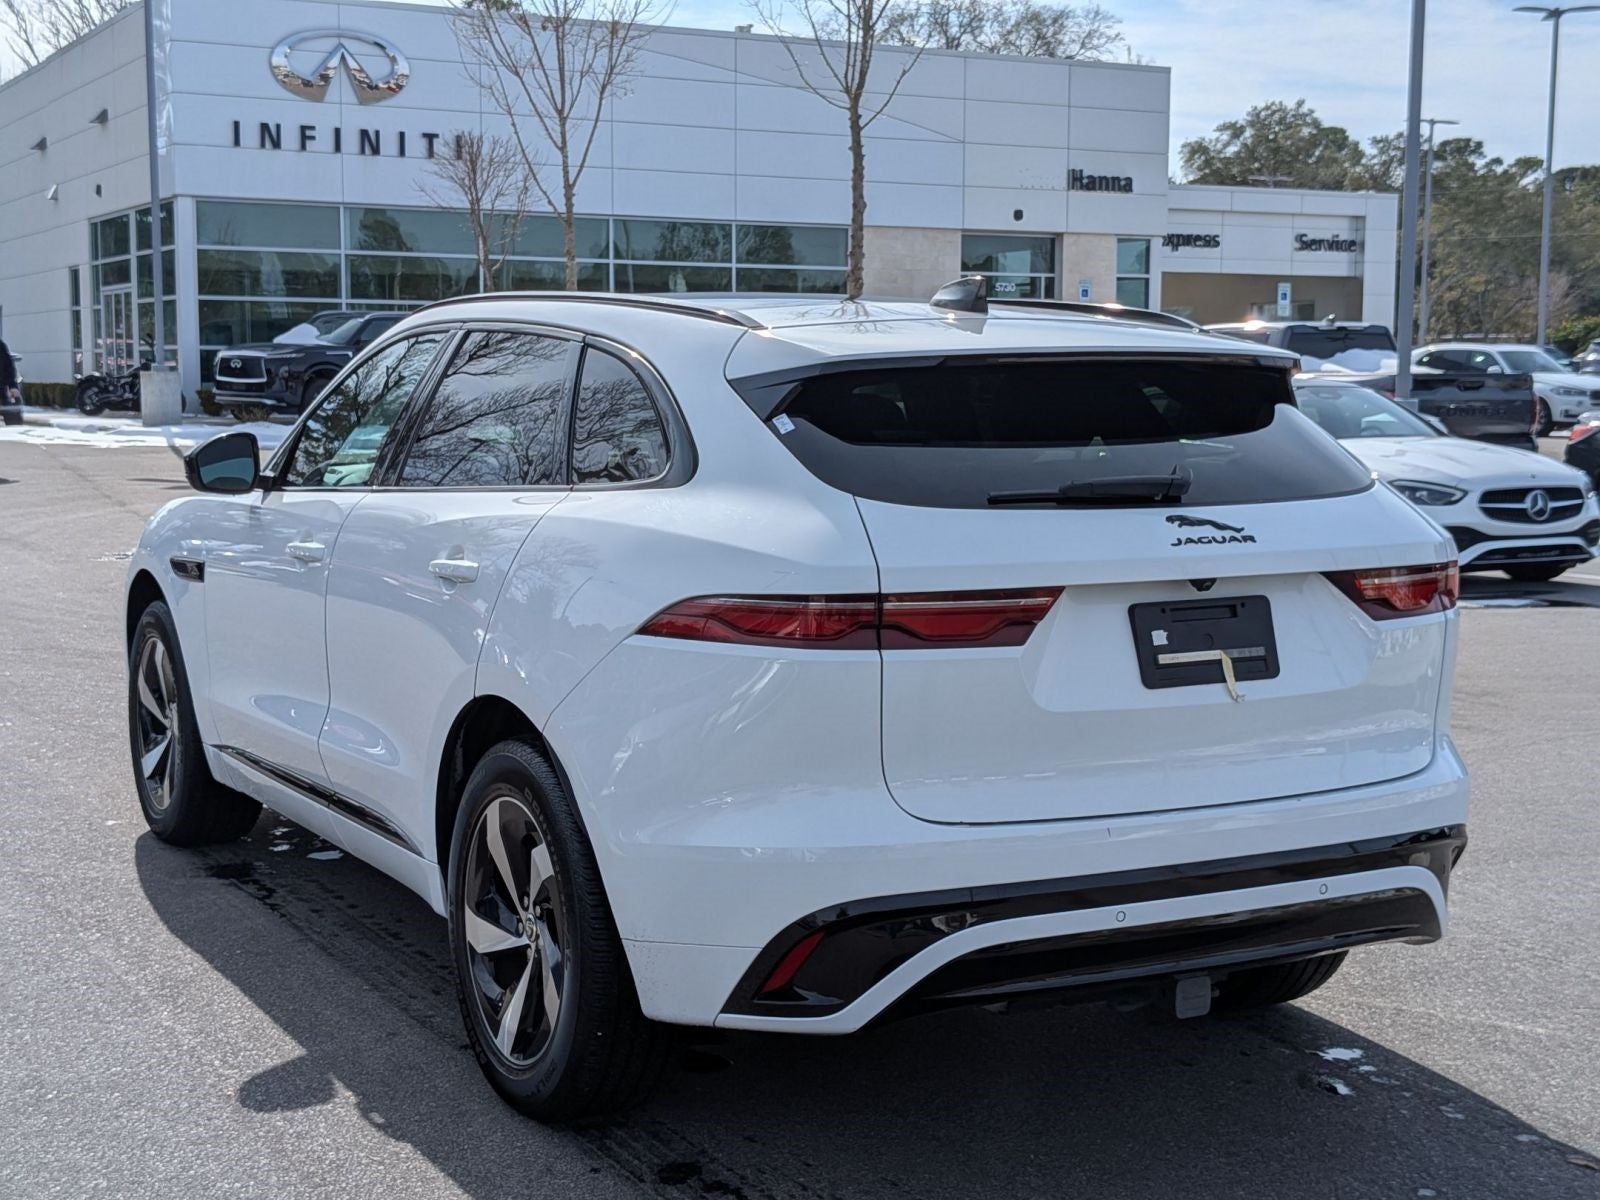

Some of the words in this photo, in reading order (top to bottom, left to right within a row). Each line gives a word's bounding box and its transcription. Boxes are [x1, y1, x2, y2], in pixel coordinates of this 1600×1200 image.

[233, 120, 463, 160] INFINITI
[1067, 168, 1133, 193] Hanna
[1162, 233, 1220, 252] xpress
[1294, 233, 1357, 252] Service
[1170, 535, 1257, 547] JAGUAR
